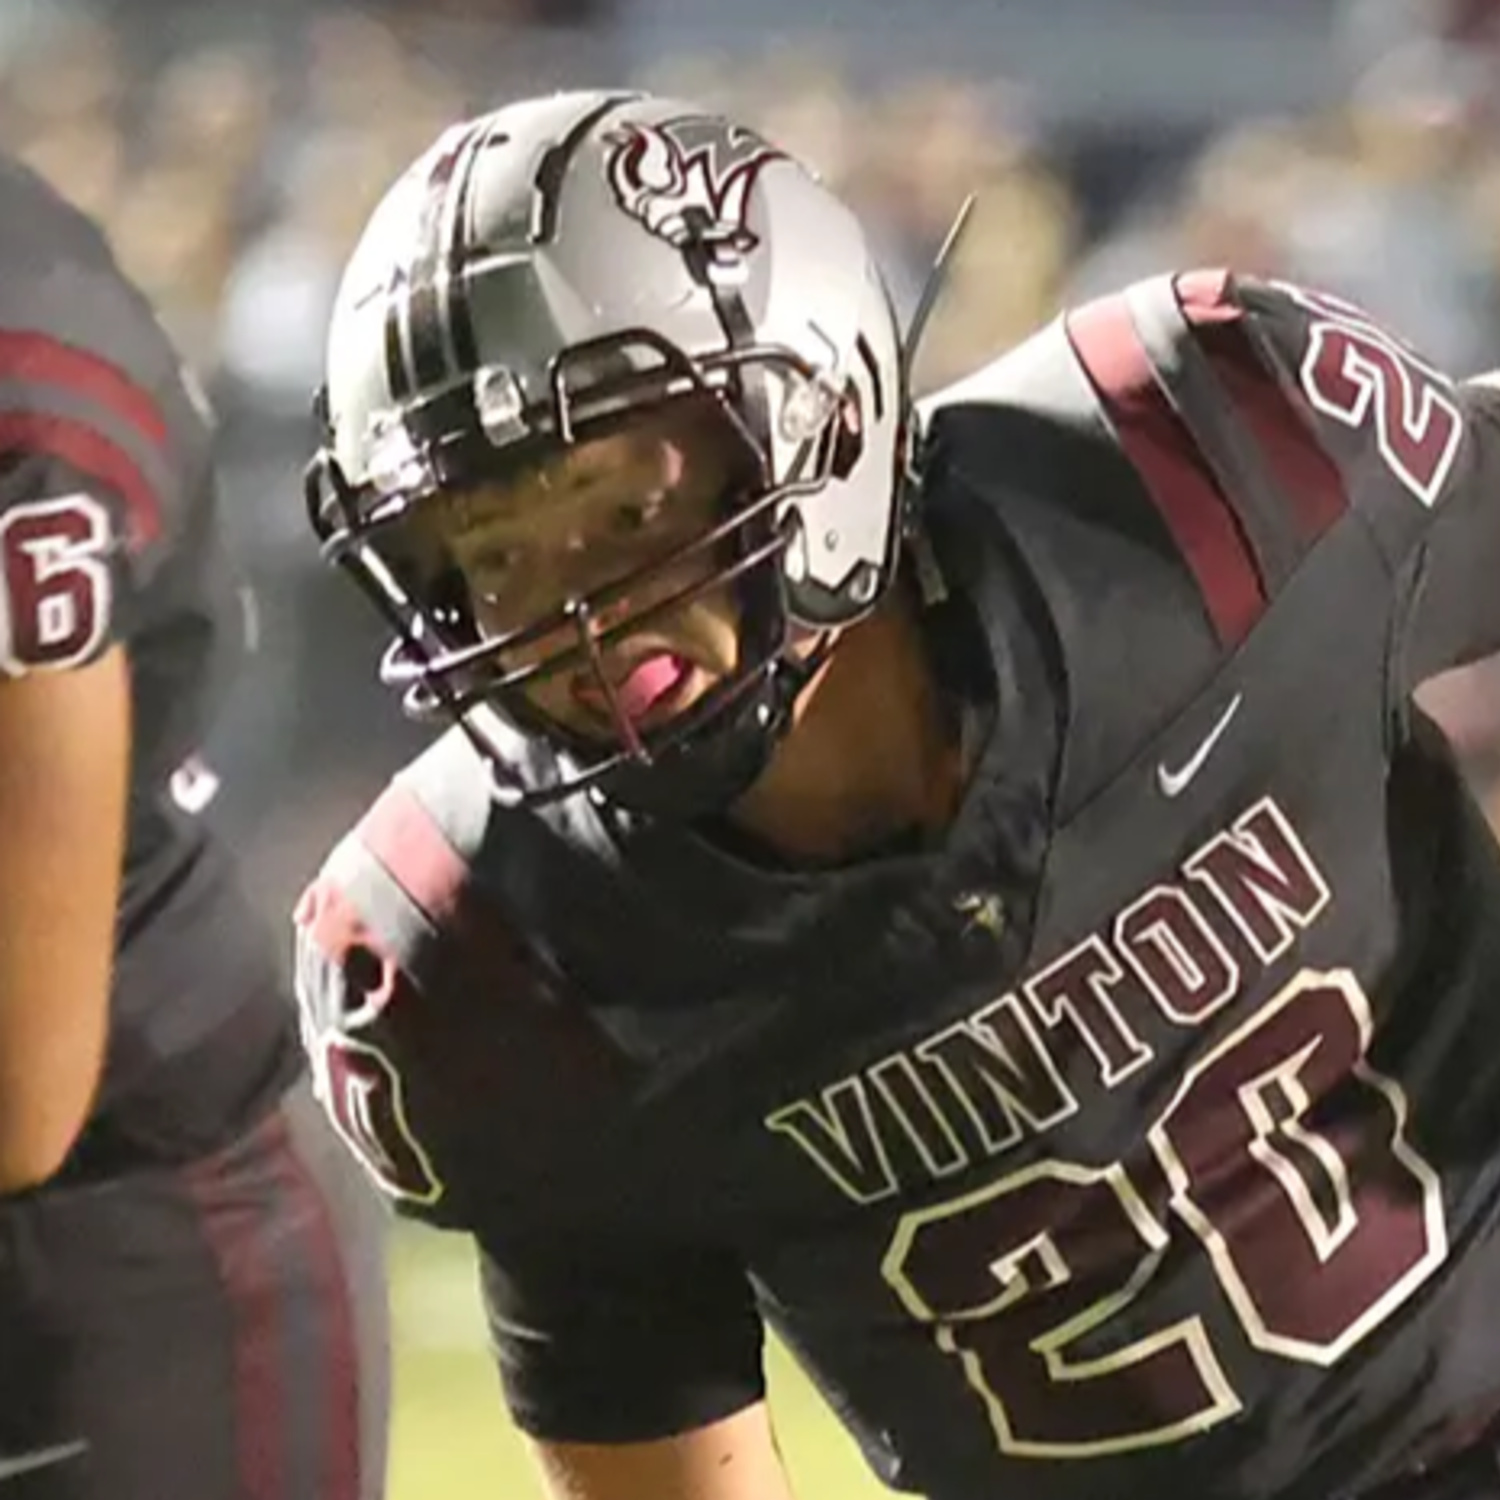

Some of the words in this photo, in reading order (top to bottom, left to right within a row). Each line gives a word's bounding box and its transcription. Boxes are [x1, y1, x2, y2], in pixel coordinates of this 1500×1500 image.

[1270, 281, 1462, 508] 2
[766, 796, 1331, 1202] VINTON
[881, 968, 1448, 1457] 20
